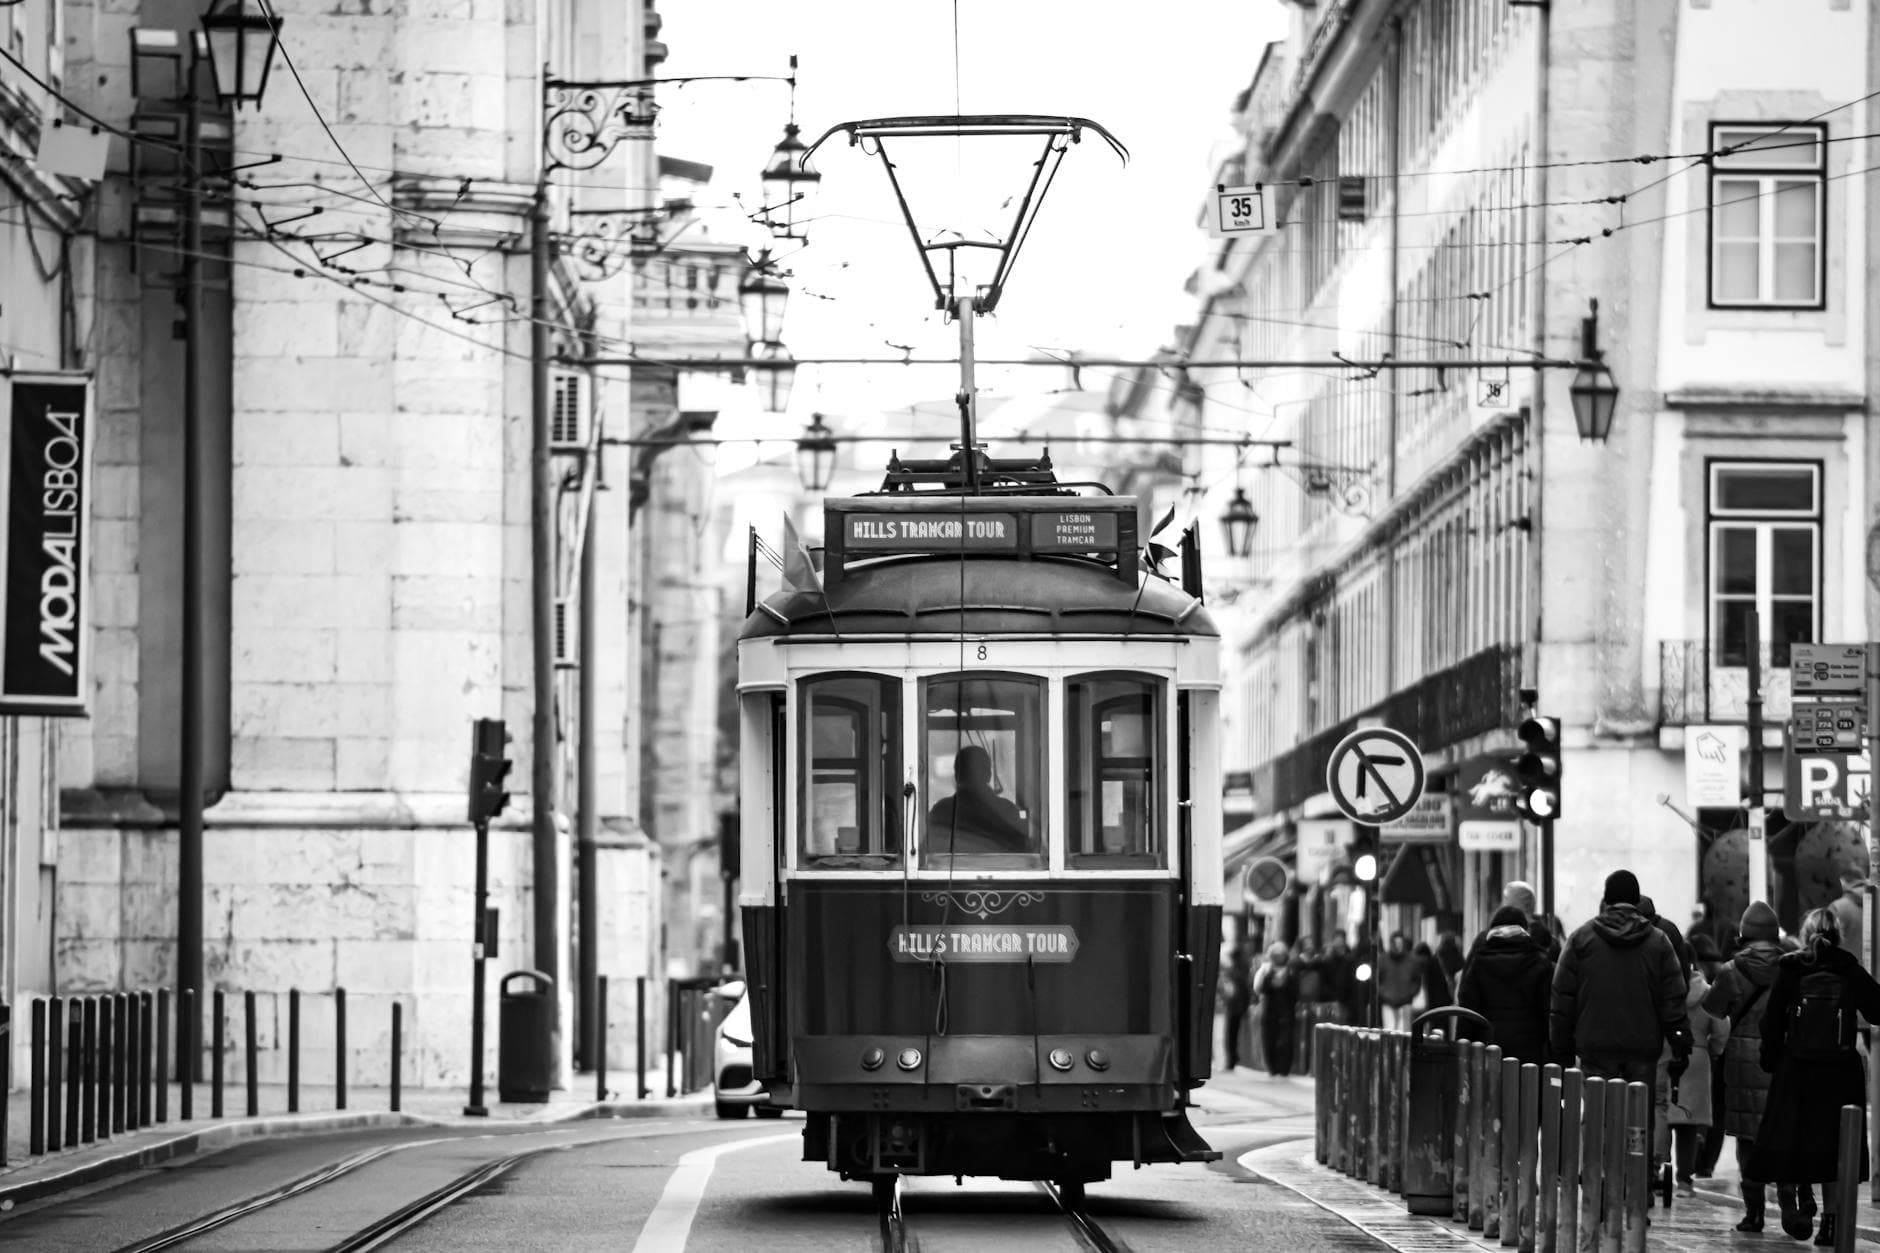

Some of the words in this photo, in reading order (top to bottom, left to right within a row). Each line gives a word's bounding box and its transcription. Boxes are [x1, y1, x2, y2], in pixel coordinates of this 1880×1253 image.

[1231, 197, 1252, 218] 35
[1059, 514, 1092, 523] LISBON
[853, 521, 897, 539] HILLS
[900, 521, 963, 539] TRAMCAR
[966, 521, 1006, 539] TOUR
[1056, 525, 1096, 534] PREMIUM
[39, 411, 80, 677] MODALISBOA
[1056, 535, 1096, 545] TRAMCAR
[977, 645, 987, 661] 8
[1801, 758, 1838, 808] P
[898, 933, 947, 953] HILLS
[950, 933, 1022, 953] TRAMCAR
[1026, 933, 1068, 953] TOUR
